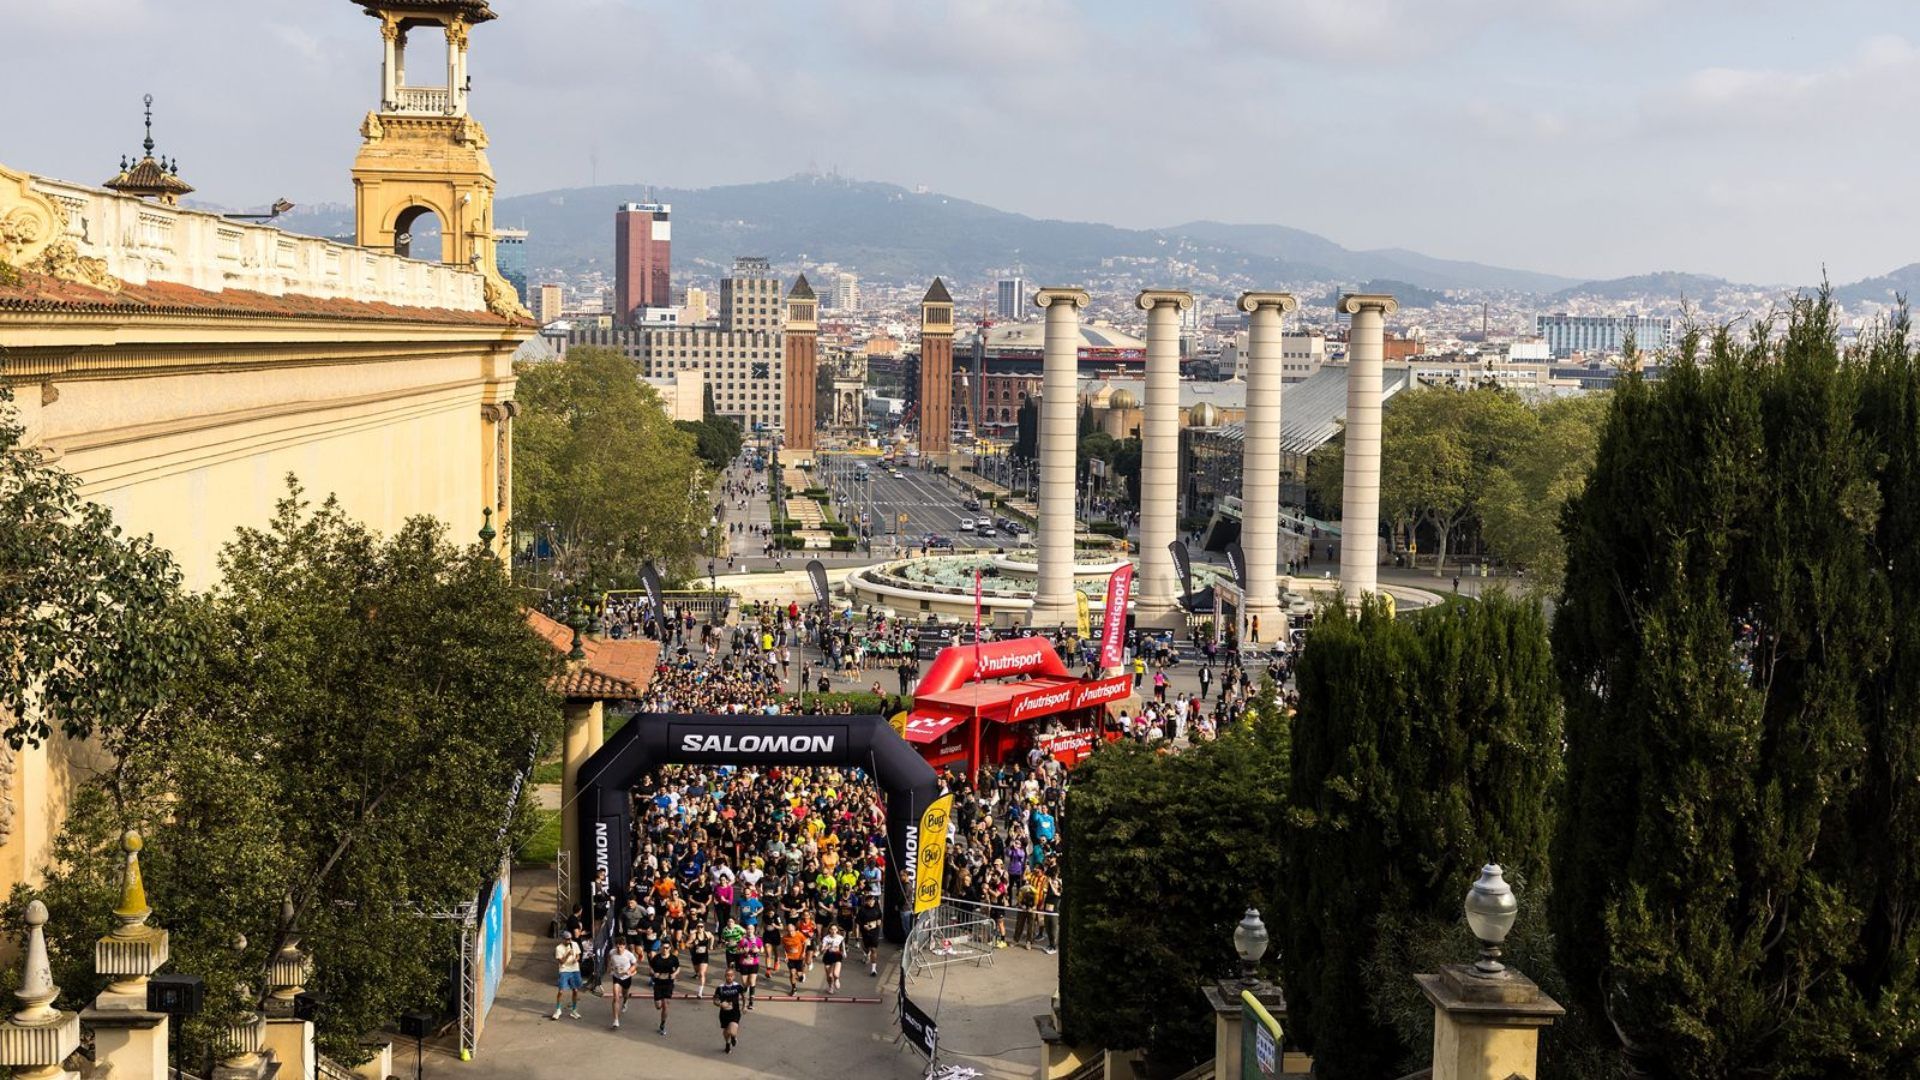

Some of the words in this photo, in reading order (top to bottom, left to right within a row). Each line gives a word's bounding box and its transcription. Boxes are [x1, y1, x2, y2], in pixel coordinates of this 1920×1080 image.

[1109, 574, 1126, 645] nutrisport
[989, 651, 1042, 670] nutrisport
[1027, 689, 1070, 709] nutrisport
[1087, 681, 1126, 700] nutrisport
[681, 734, 834, 752] SALOMON
